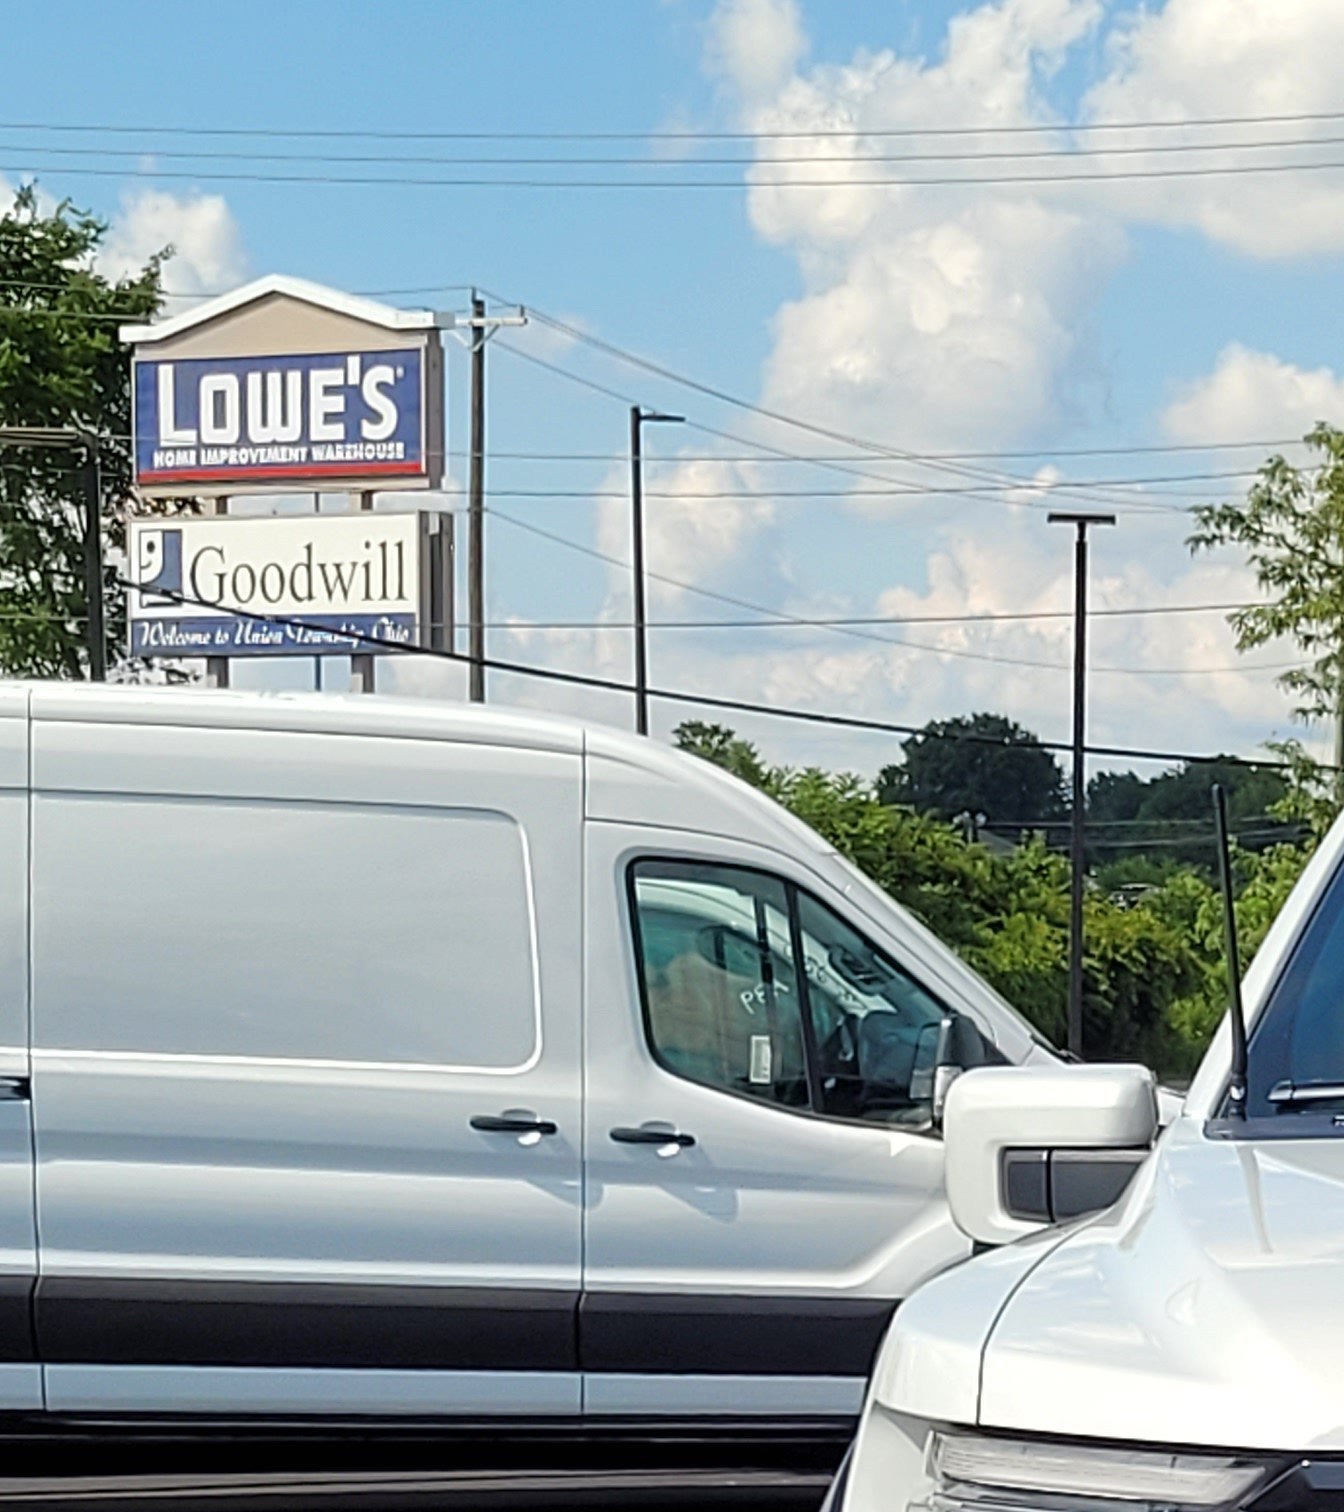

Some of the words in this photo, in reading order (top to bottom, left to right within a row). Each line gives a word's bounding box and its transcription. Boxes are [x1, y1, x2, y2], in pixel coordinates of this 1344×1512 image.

[156, 354, 399, 448] LOWE'S
[153, 448, 197, 470] HOME
[200, 445, 308, 467] IMPROVEMENT
[311, 442, 405, 462] WAREHOUSE
[190, 540, 409, 606] Goodwill
[139, 620, 211, 646] Welcome
[214, 625, 230, 646] to
[234, 618, 284, 646] Union
